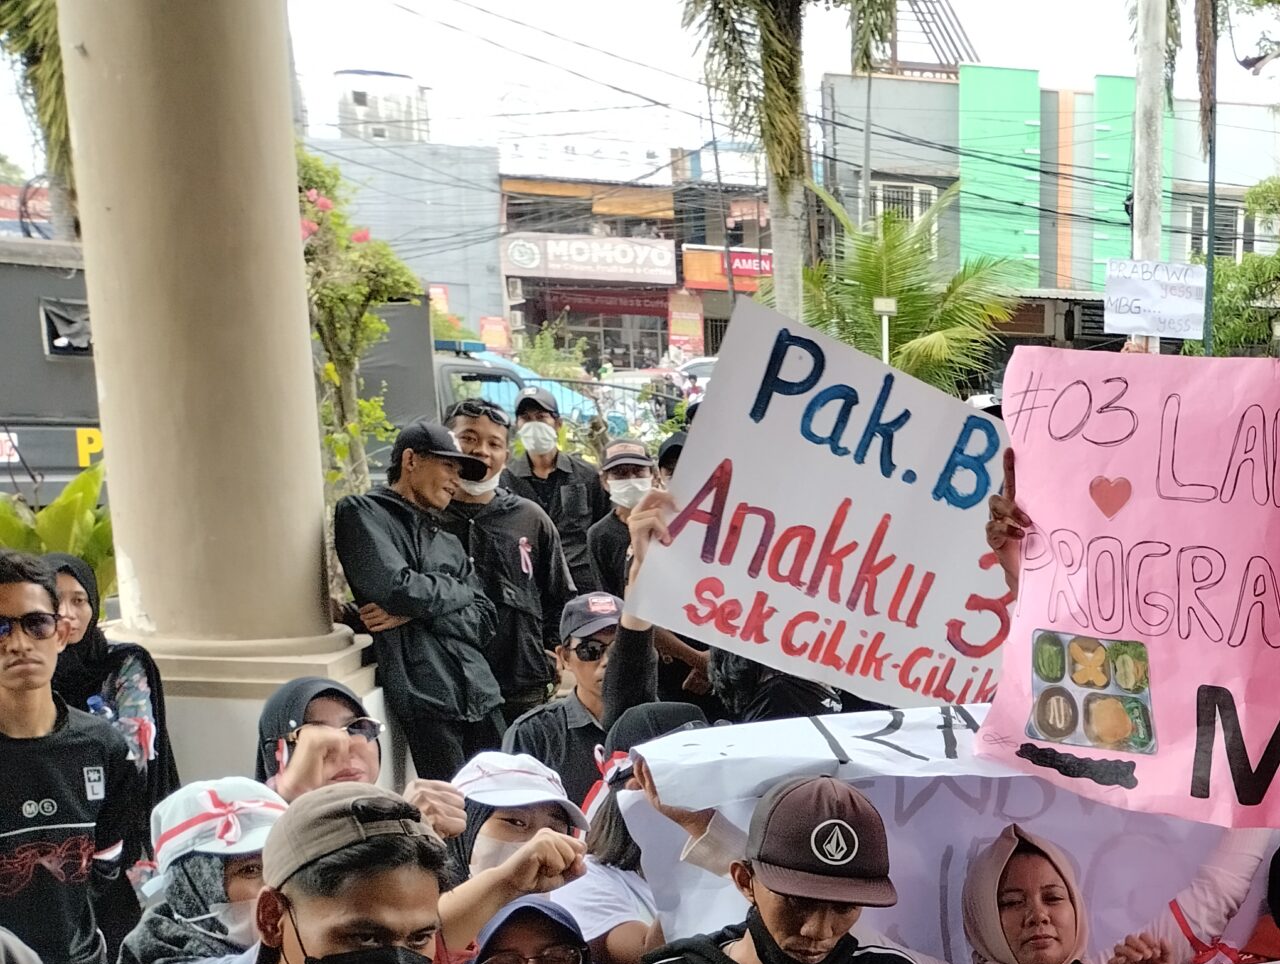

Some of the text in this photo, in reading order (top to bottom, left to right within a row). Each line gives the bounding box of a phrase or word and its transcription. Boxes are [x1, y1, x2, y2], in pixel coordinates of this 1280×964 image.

[547, 239, 672, 267] MOMOYO
[724, 258, 770, 271] AMEN
[749, 328, 1004, 510] Pak. B
[1008, 371, 1139, 447] #03
[659, 458, 936, 629] Anakku
